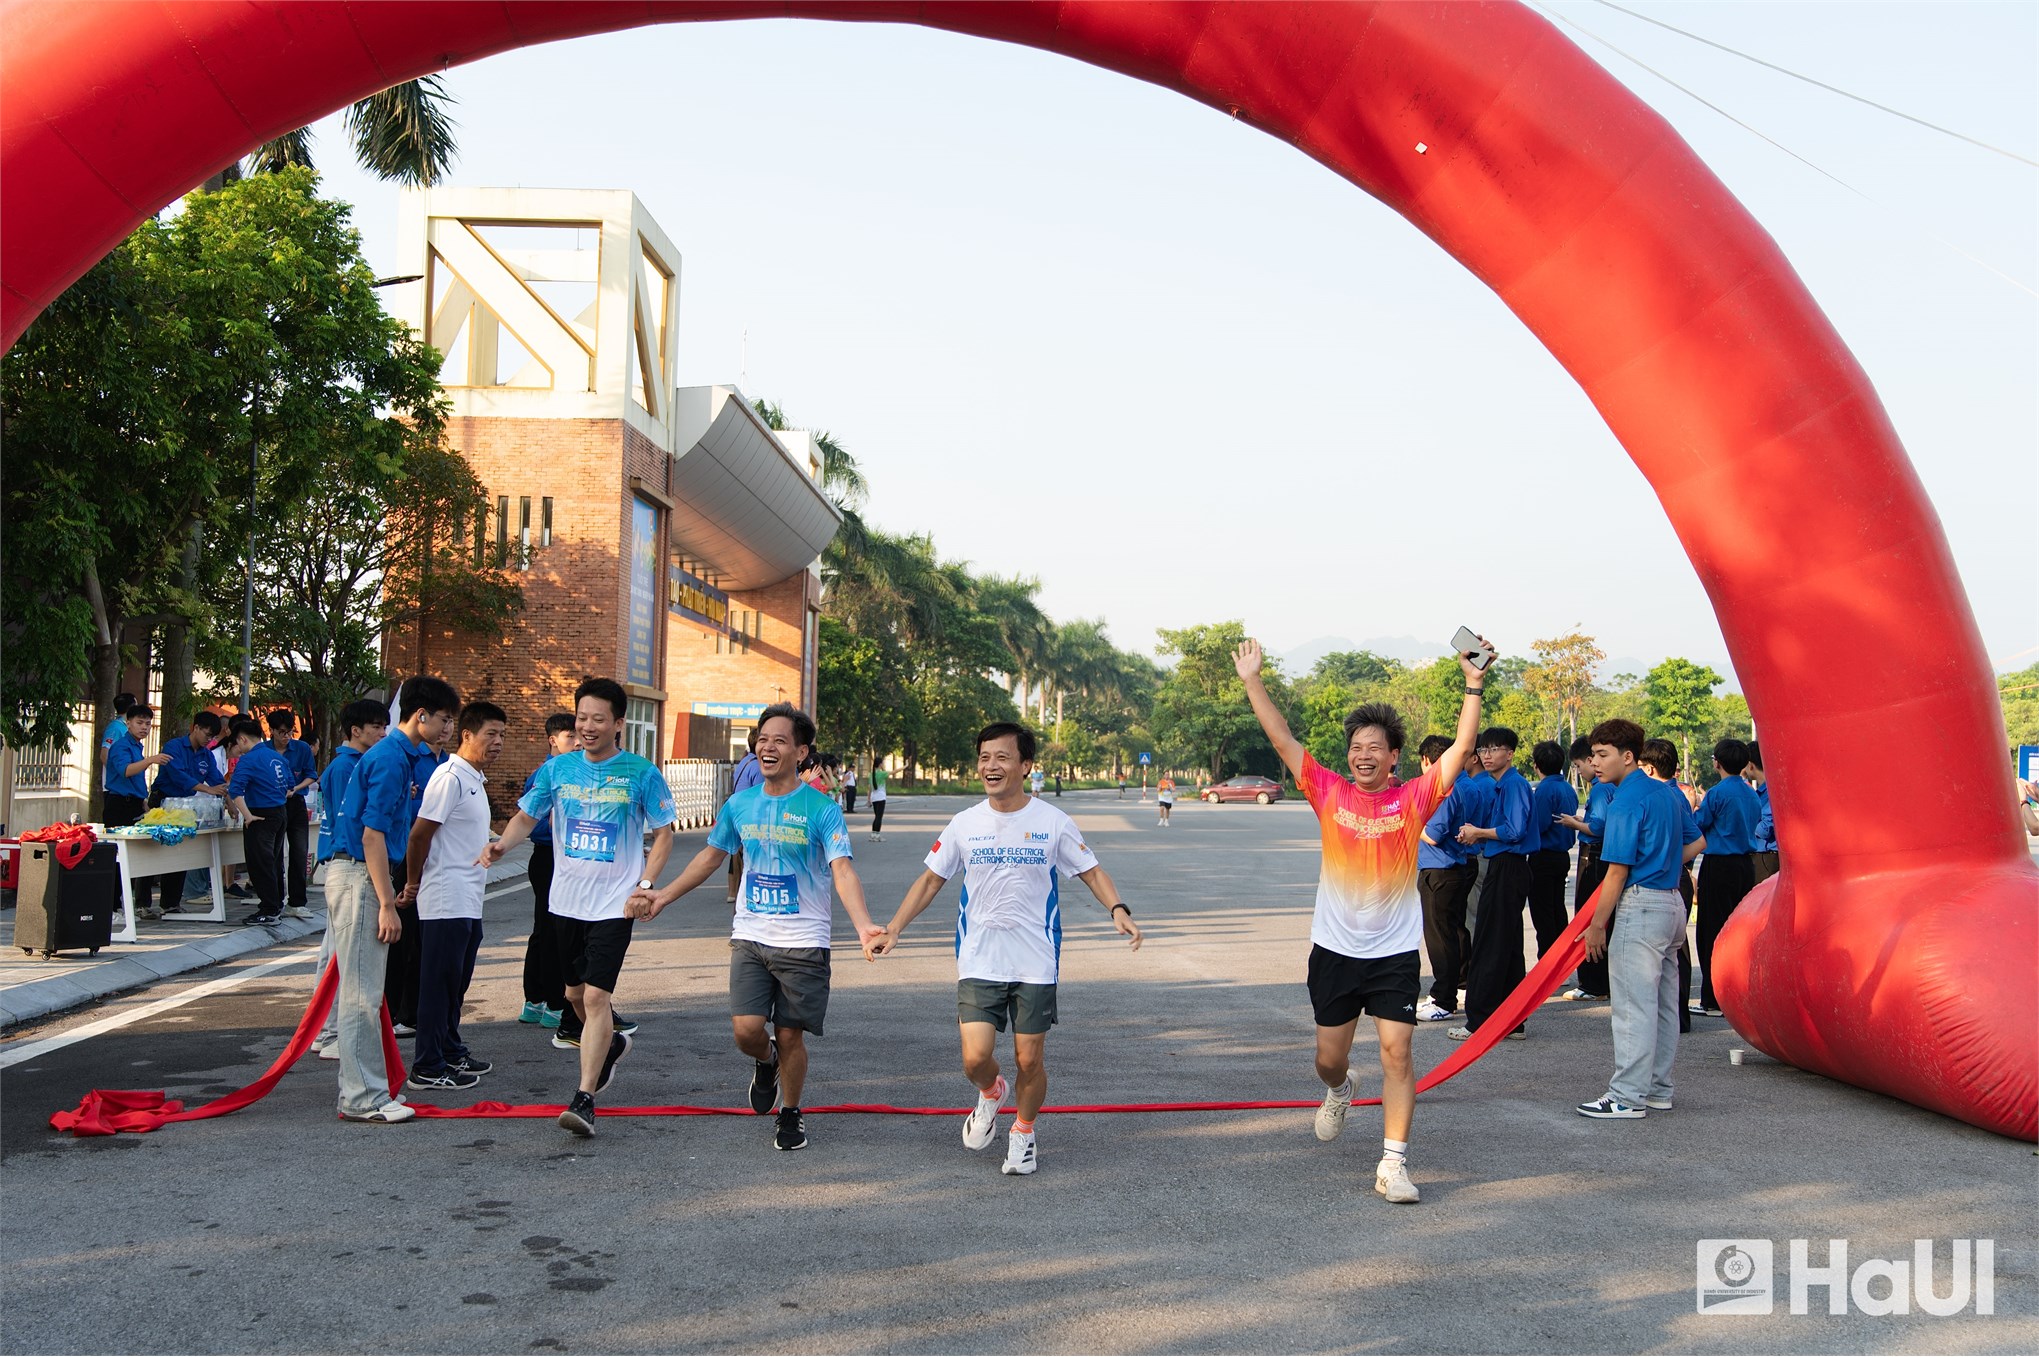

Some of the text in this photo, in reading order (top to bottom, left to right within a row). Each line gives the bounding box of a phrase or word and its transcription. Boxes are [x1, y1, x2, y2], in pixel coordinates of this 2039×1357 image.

[790, 814, 807, 824] HaUI
[571, 832, 608, 852] 5031
[972, 848, 1045, 856] SCHOOL OF ELECTRICAL
[1006, 856, 1048, 864] ENGINEERING
[752, 886, 790, 904] 5015
